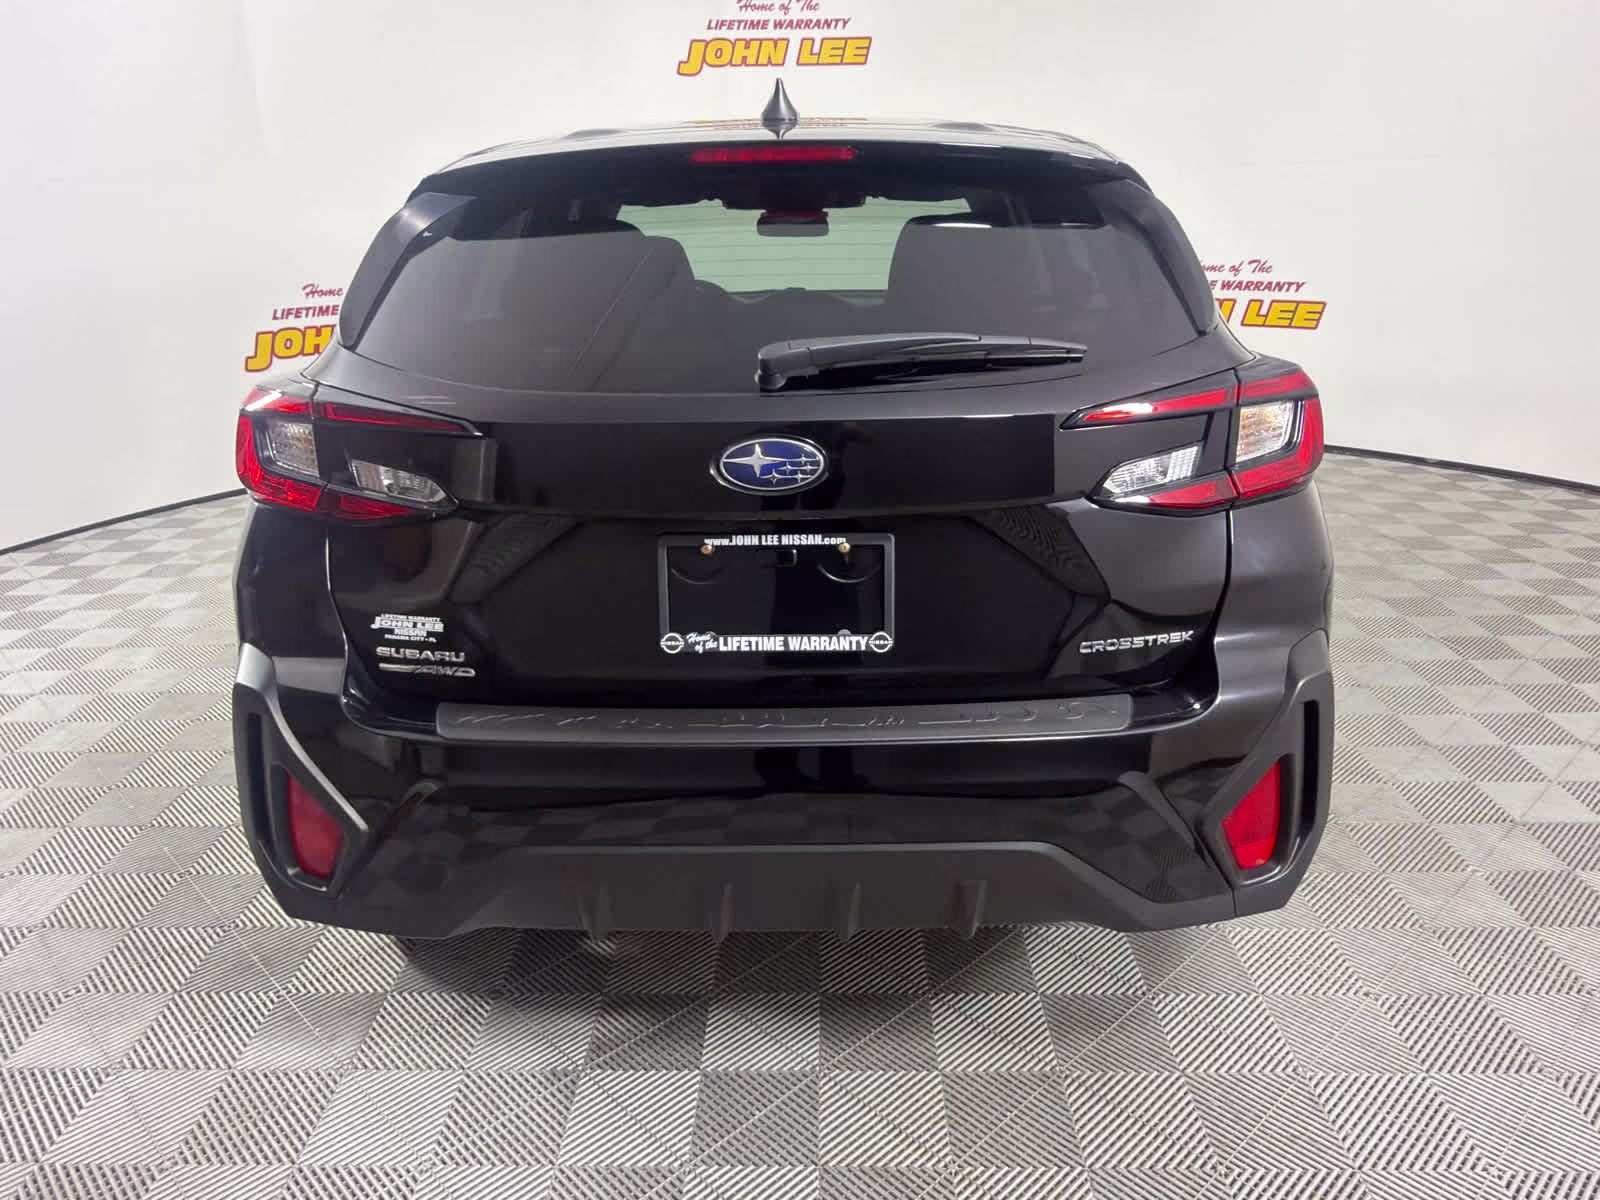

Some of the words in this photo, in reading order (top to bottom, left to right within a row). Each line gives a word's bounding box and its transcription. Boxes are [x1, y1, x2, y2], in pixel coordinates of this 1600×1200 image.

[736, 0, 775, 12] Home
[779, 0, 790, 15] of
[795, 0, 820, 12] The
[706, 19, 770, 31] LIFETIME
[773, 18, 852, 31] WARRANTY
[677, 38, 790, 77] JOHN
[796, 36, 873, 67] LEE
[1228, 260, 1244, 277] of
[1247, 258, 1273, 275] The
[302, 283, 344, 299] Home
[1219, 280, 1306, 293] WARRANTY
[272, 304, 340, 320] LIFETIME
[1239, 298, 1328, 331] LEE
[244, 323, 336, 373] JOH
[762, 534, 780, 546] LEE
[370, 616, 414, 629] JOHN
[416, 620, 444, 632] LEE
[695, 641, 704, 654] of
[719, 636, 785, 652] LIFETIME
[787, 635, 869, 651] WARRANTY
[1079, 629, 1195, 654] CROSSTREK
[376, 646, 465, 662] SUBARU
